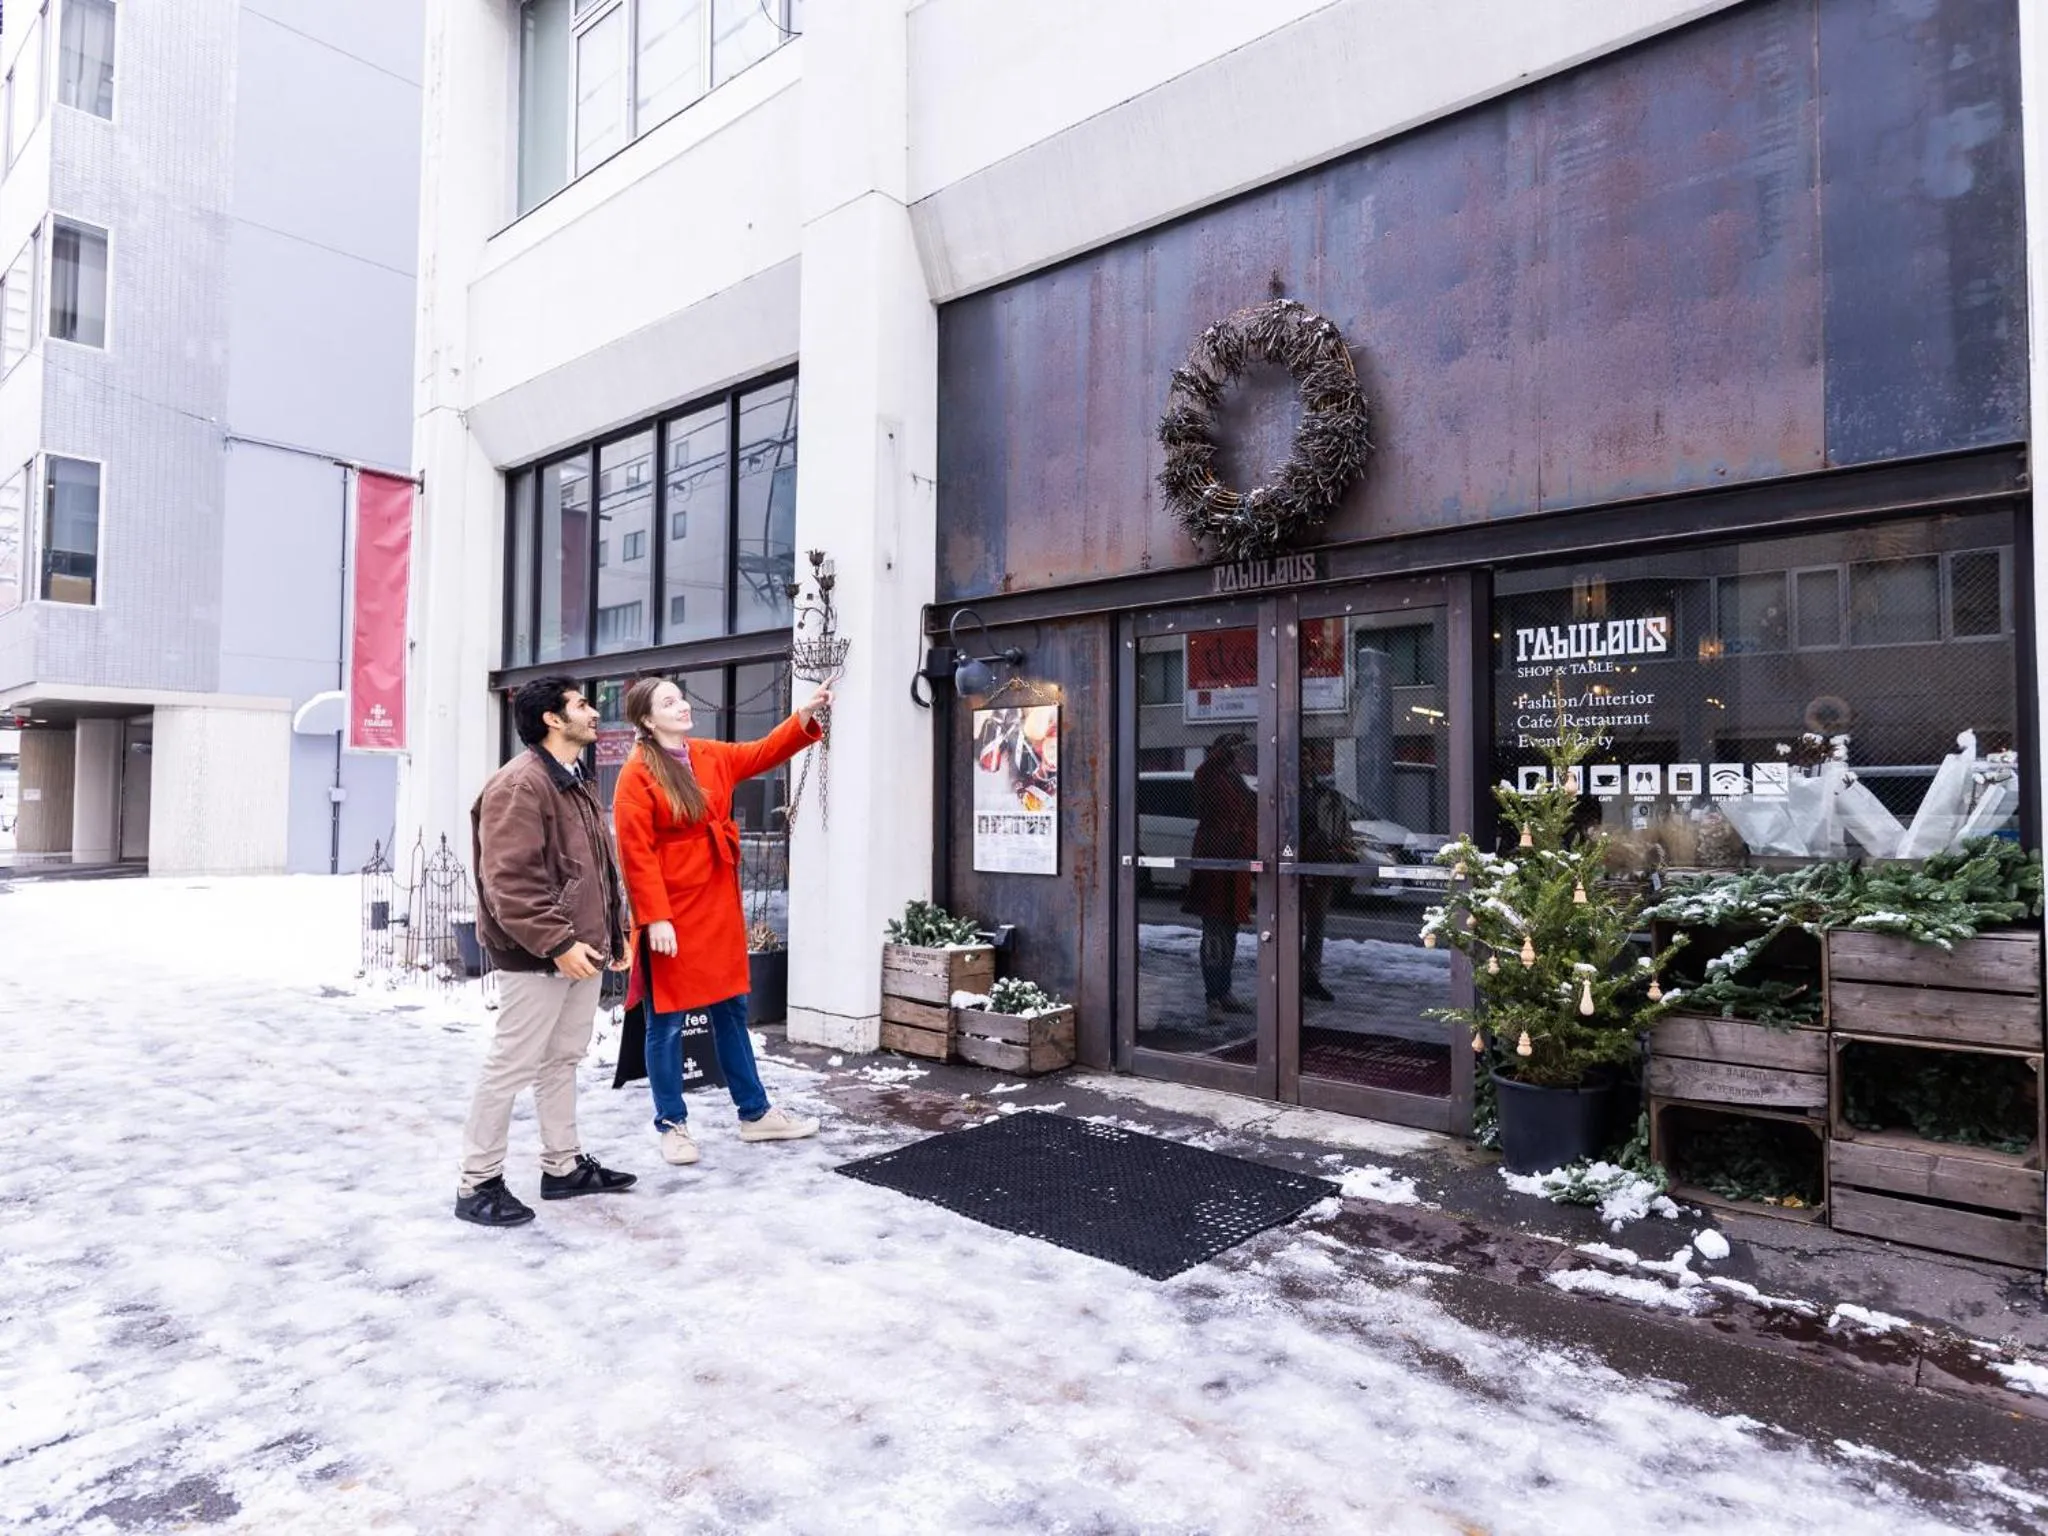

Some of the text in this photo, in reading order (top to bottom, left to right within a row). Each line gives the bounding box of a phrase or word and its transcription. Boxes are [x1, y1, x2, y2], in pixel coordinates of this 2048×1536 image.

[1517, 661, 1614, 678] SHOP & TABLE
[1518, 690, 1655, 710] Fashion/Interior
[1517, 712, 1651, 729] Cafe/Restaurant
